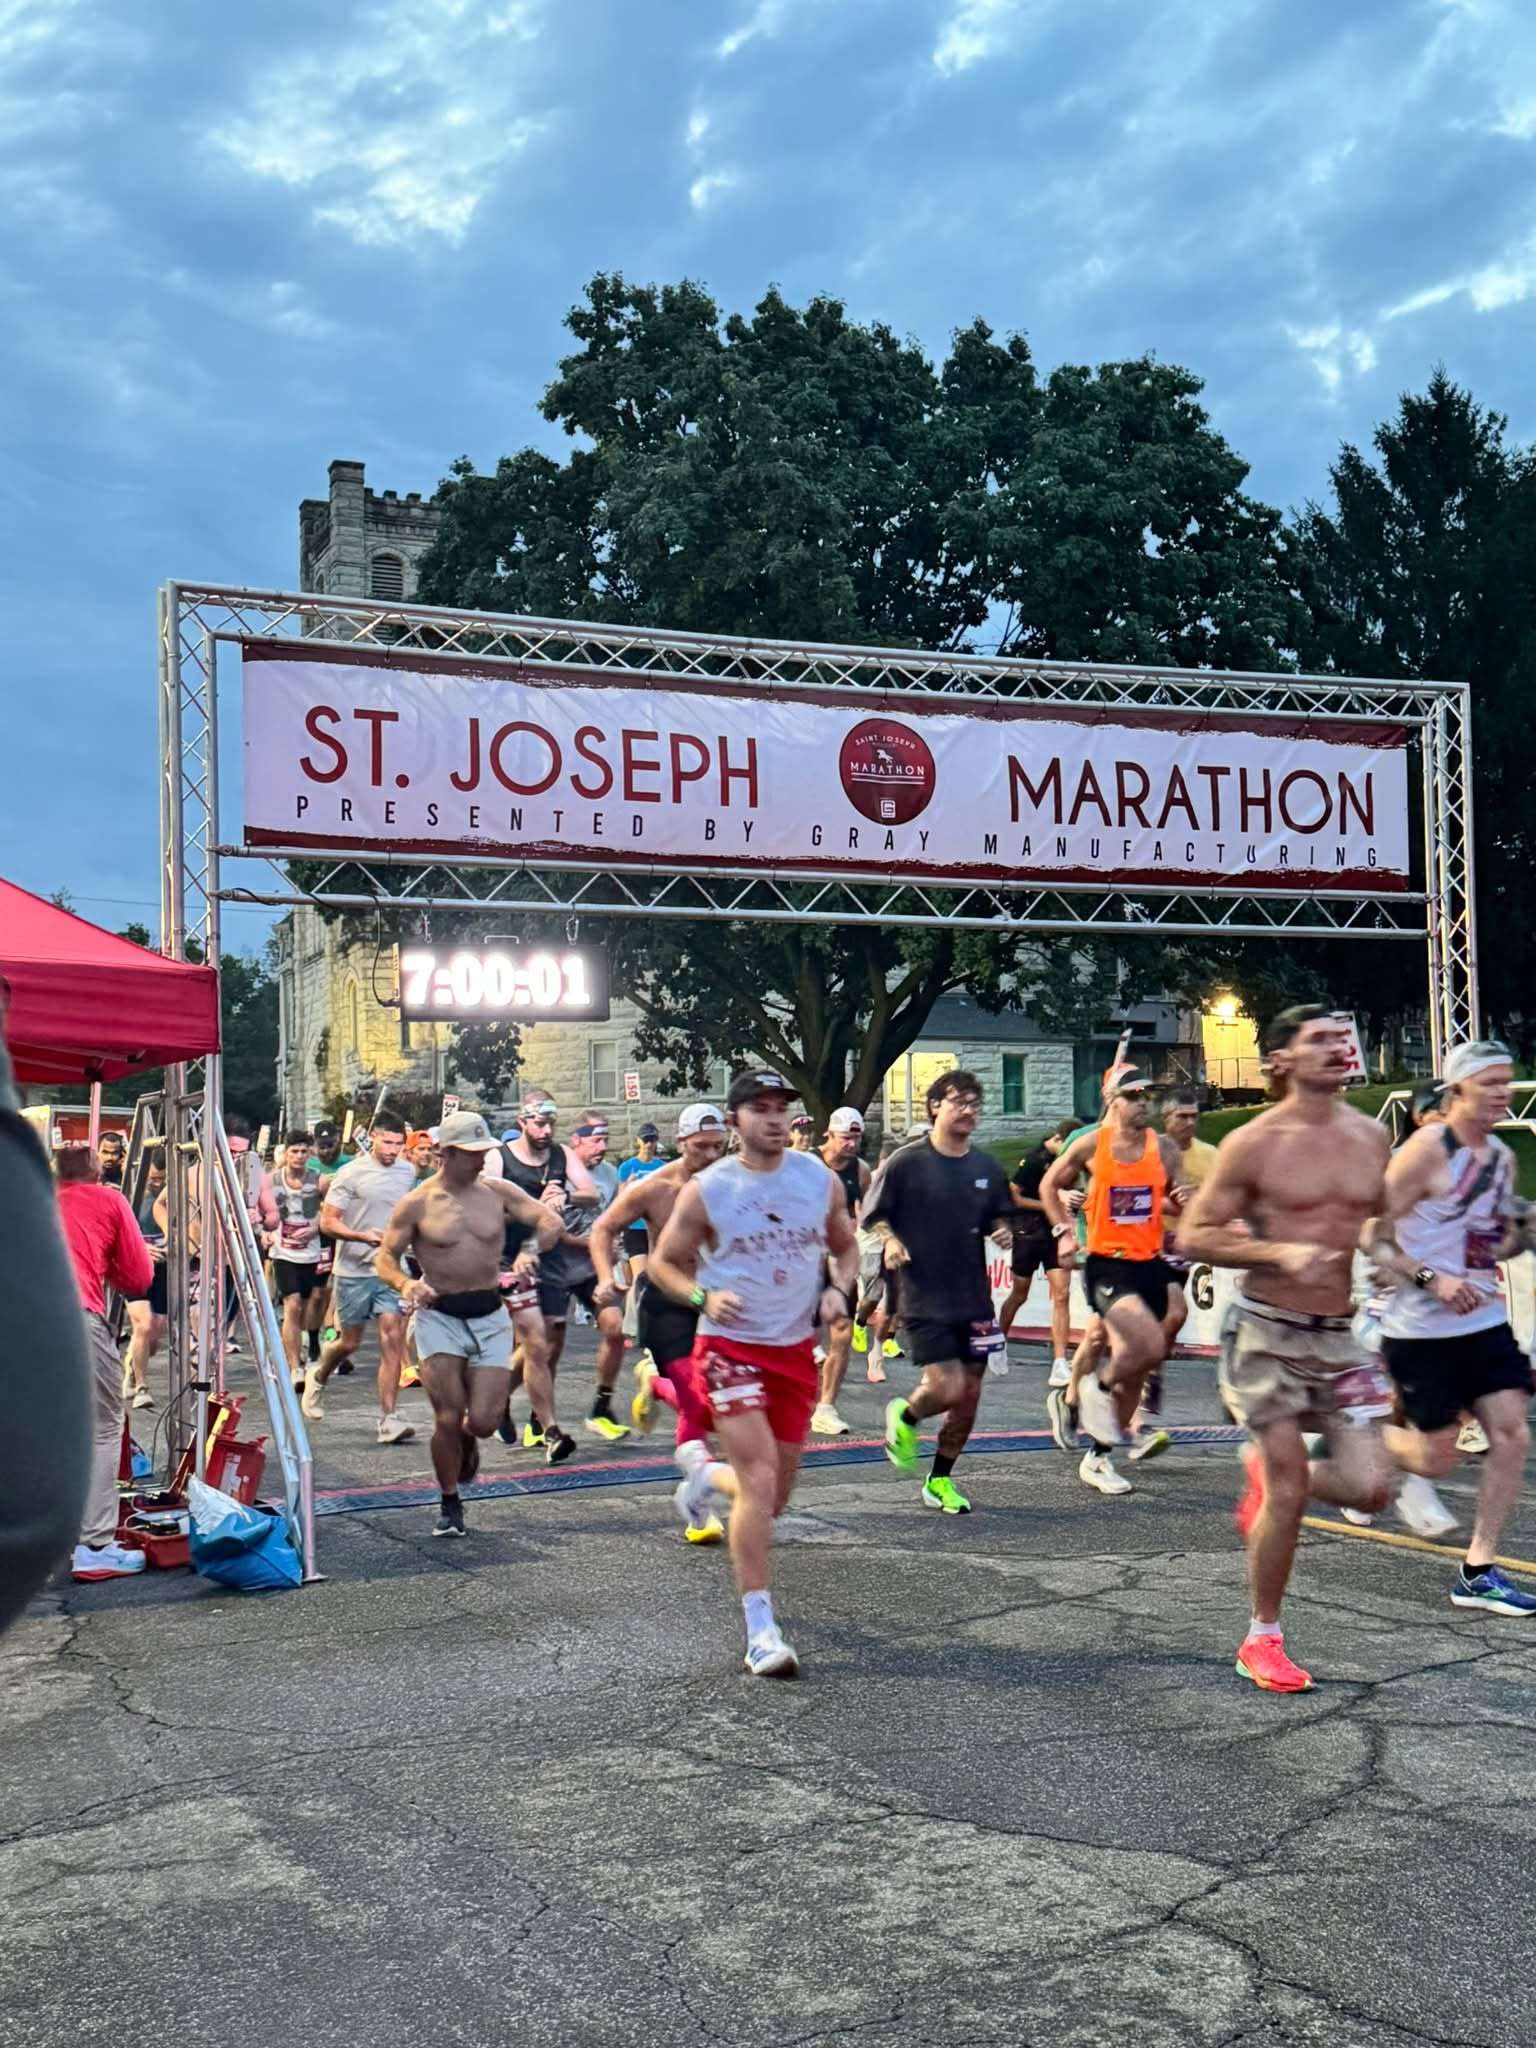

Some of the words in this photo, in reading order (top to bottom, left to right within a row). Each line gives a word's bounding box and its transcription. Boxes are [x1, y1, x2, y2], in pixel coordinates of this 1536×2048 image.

[299, 705, 410, 789] ST.
[449, 717, 759, 809] JOSEPH
[850, 762, 925, 776] MARATHON
[855, 734, 879, 746] SAINT
[882, 736, 916, 750] JOSEPH
[1007, 754, 1375, 837] MARATHON
[296, 795, 643, 837] PRESENTED
[704, 818, 754, 843] BY
[811, 824, 929, 852] GRAY
[984, 833, 1377, 868] MANUFACTURING
[401, 953, 591, 1007] 7:00:01
